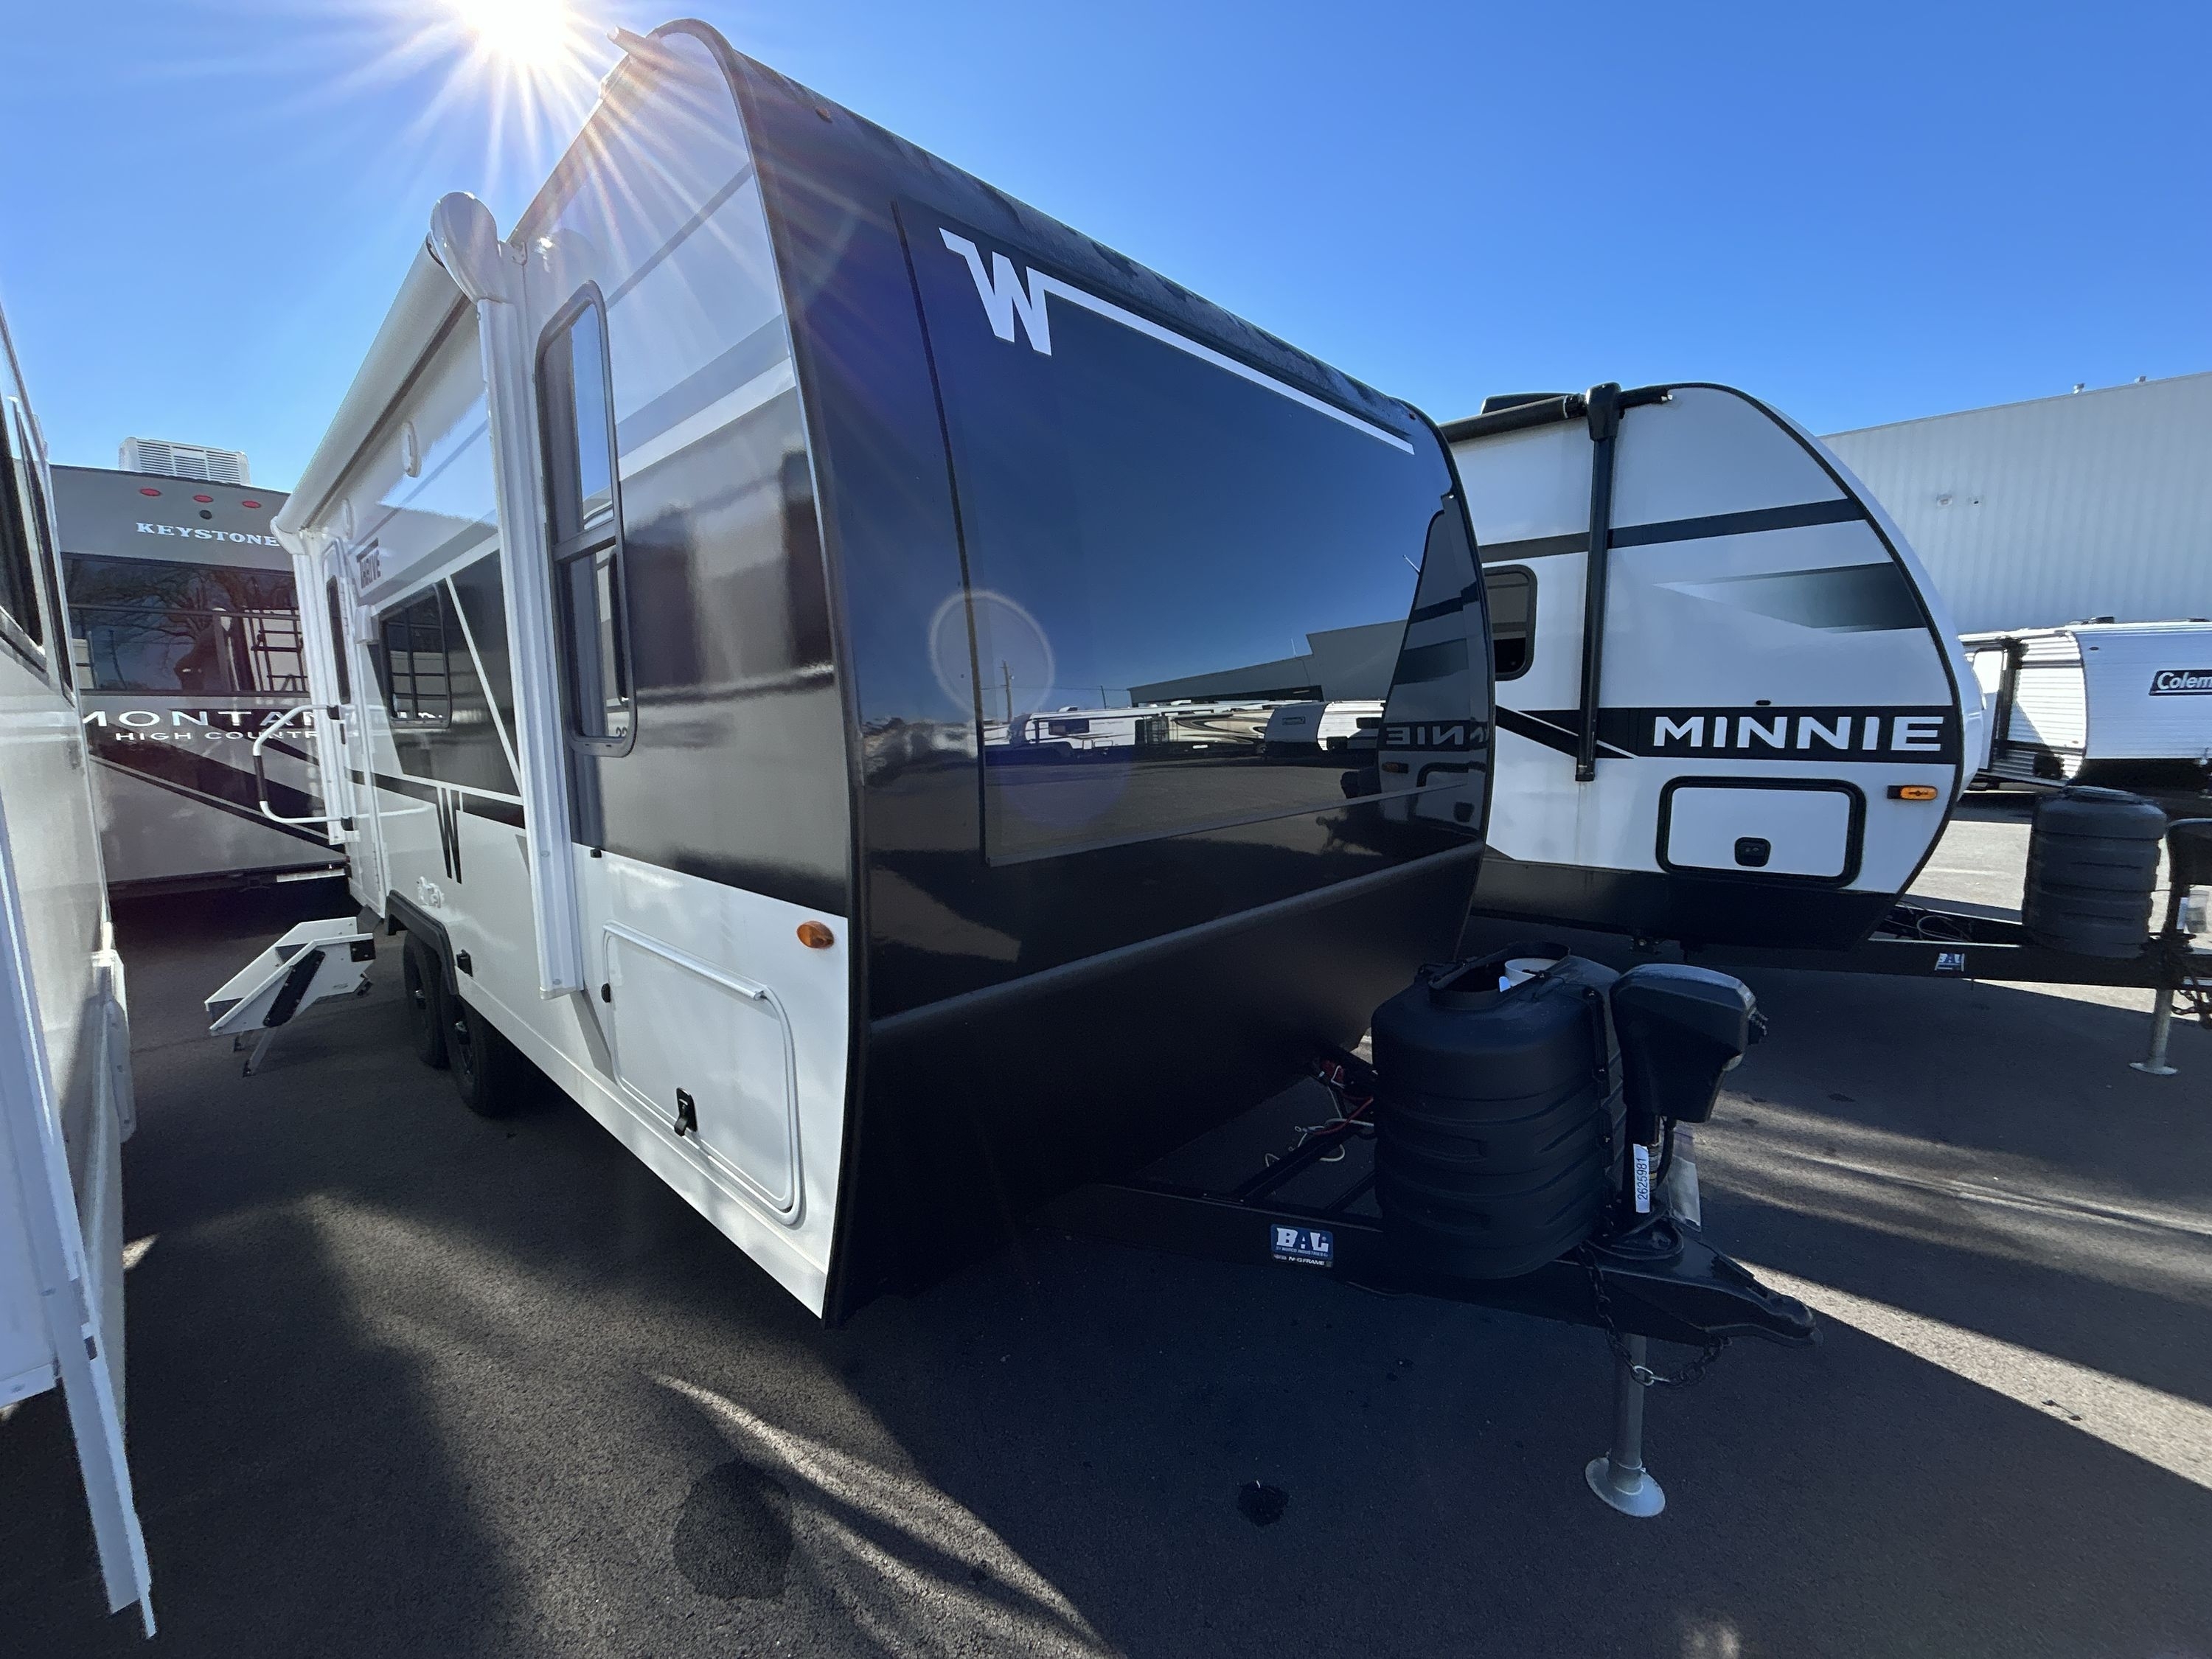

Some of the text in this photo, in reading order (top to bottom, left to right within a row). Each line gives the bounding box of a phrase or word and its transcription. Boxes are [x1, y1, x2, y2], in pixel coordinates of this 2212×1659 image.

[136, 522, 280, 547] KEYSTONE
[115, 732, 191, 741] HIGH
[1653, 716, 1944, 751] MINNIE
[1635, 1157, 1649, 1200] 2625981
[1276, 1228, 1329, 1252] BAL
